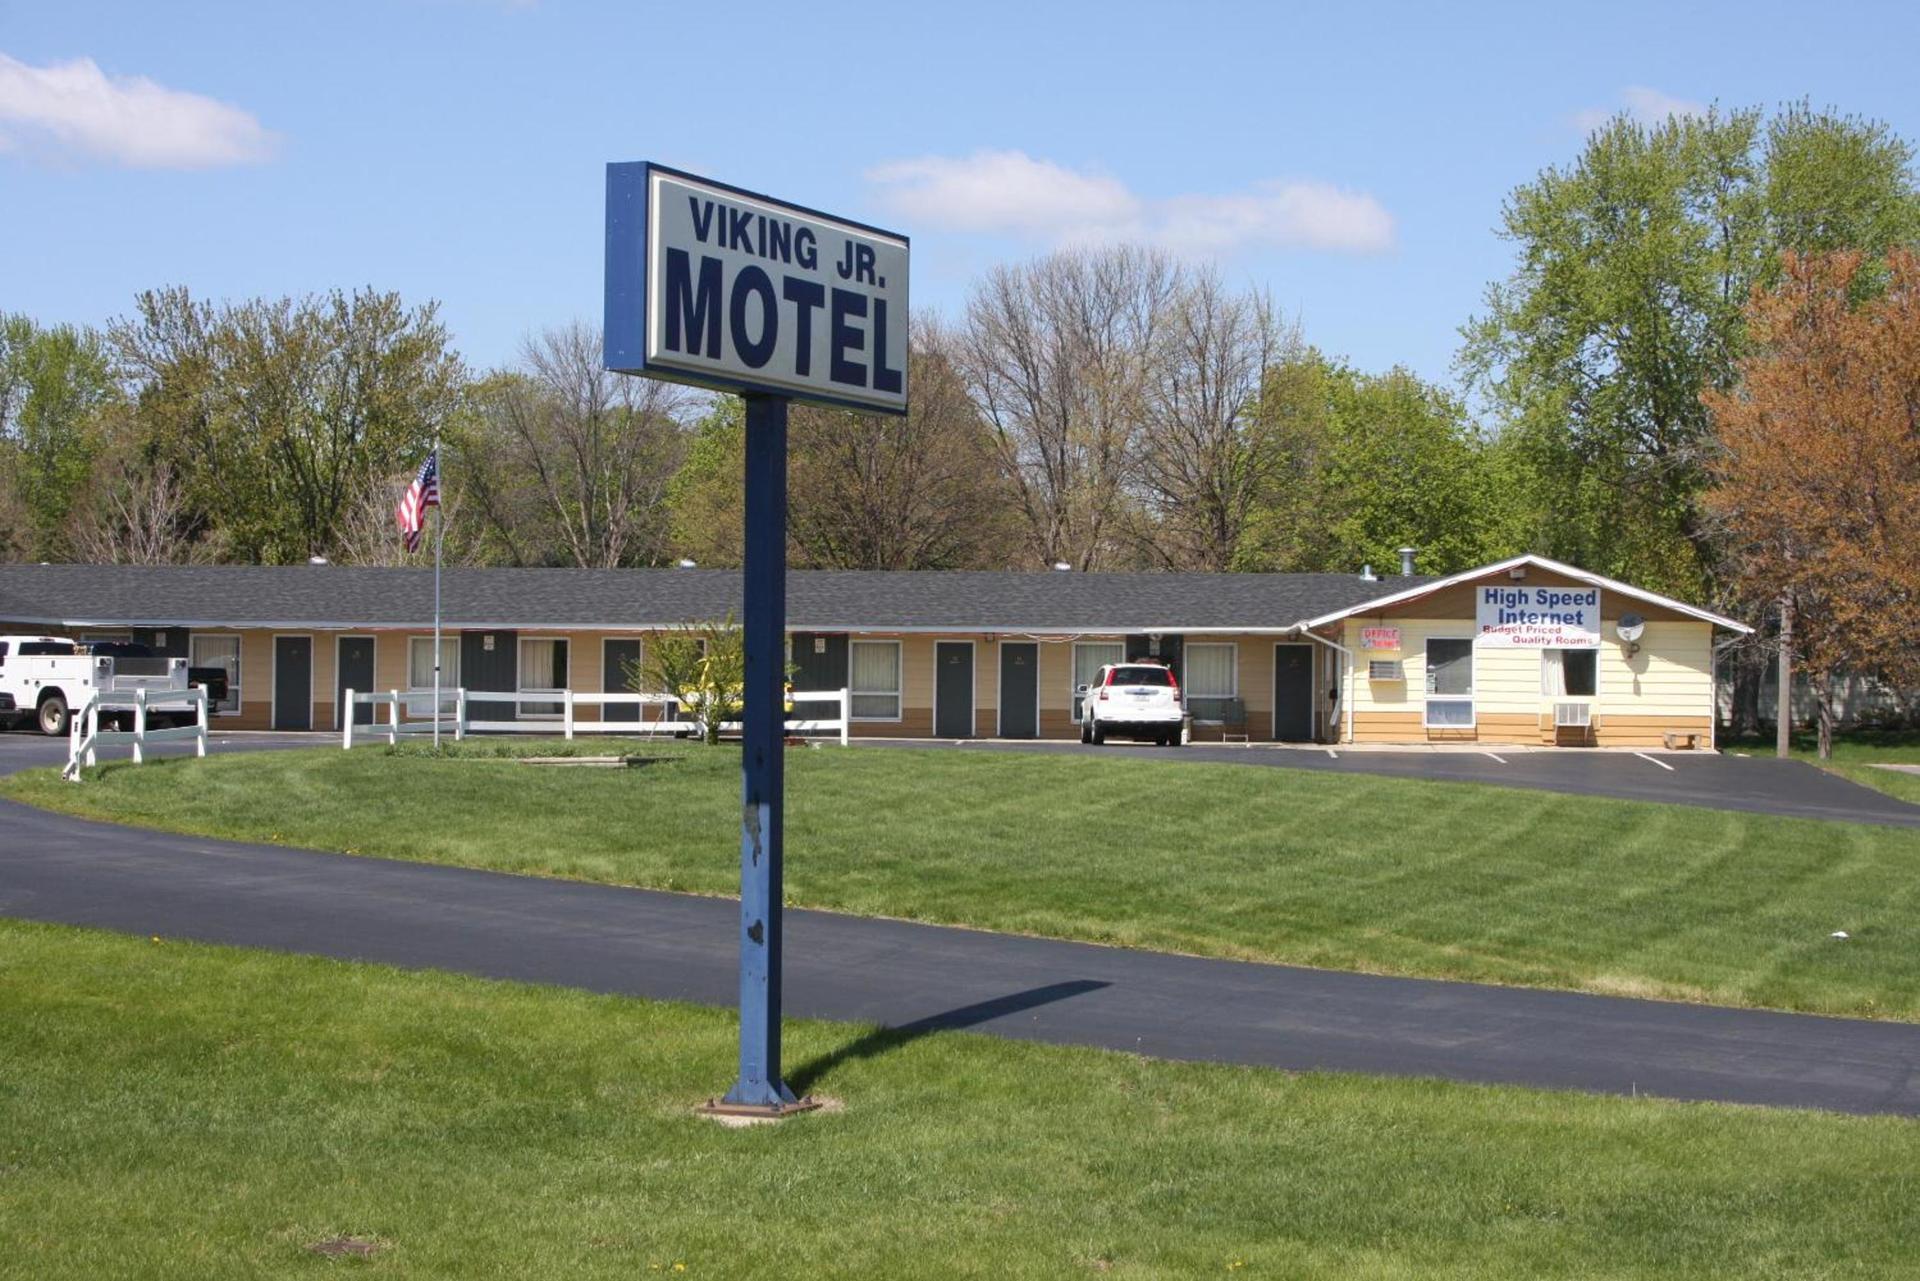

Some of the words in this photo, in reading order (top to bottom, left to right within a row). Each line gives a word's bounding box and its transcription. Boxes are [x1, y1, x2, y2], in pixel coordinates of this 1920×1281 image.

[689, 196, 818, 271] VIKING
[836, 240, 886, 288] JR.
[665, 246, 902, 394] MOTEL
[1484, 588, 1530, 609] High
[1536, 589, 1596, 609] Speed
[1498, 608, 1584, 625] Internet
[1482, 625, 1522, 635] Budget
[1526, 626, 1562, 634] Priced
[1512, 635, 1552, 645] Quality
[1555, 636, 1593, 645] Rooms
